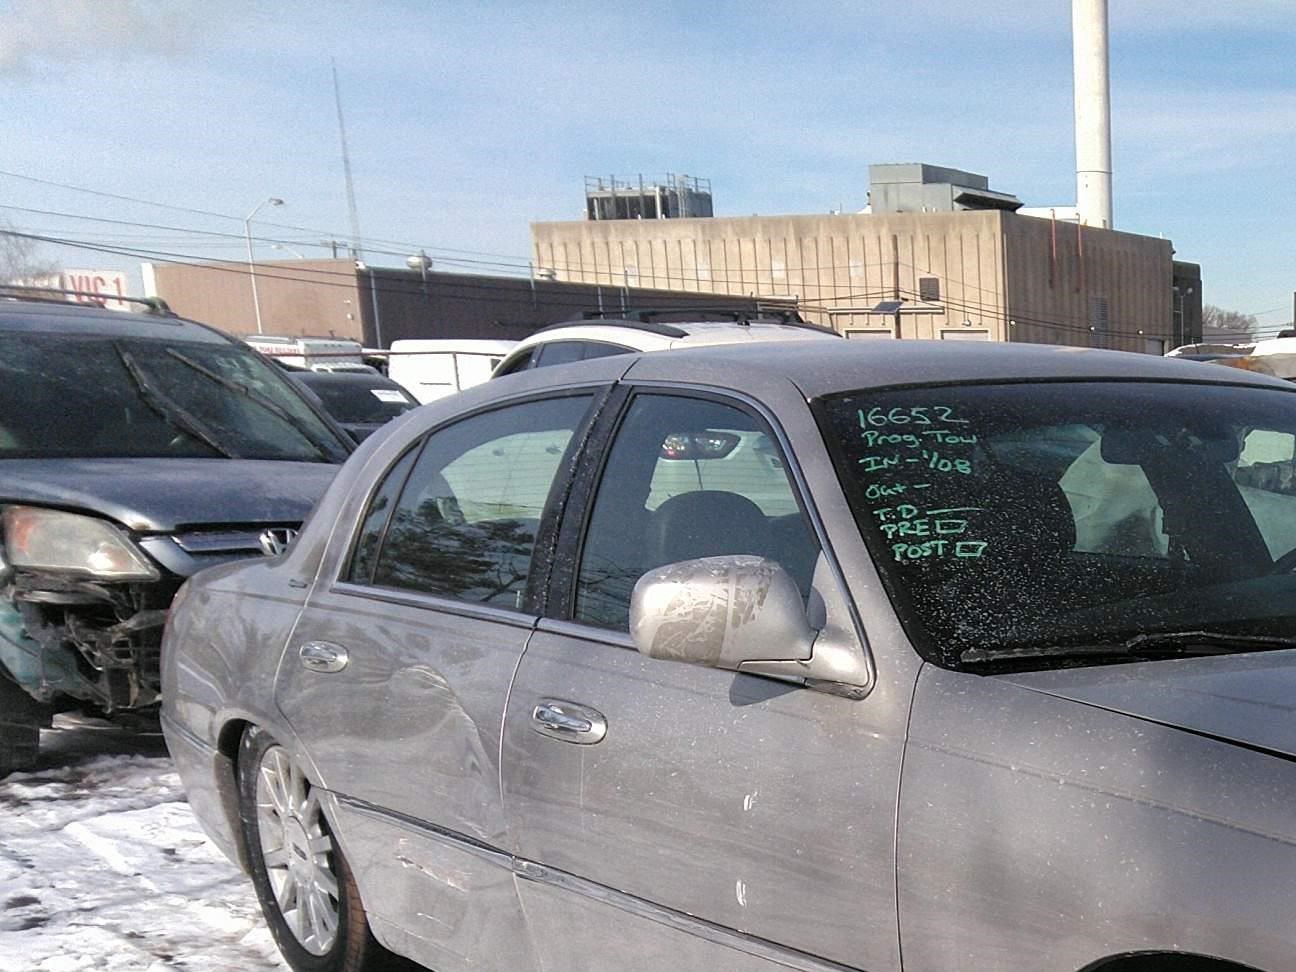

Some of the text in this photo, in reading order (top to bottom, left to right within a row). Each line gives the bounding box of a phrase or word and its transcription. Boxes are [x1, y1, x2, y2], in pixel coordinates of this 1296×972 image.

[858, 406, 970, 429] 16652
[922, 430, 977, 444] Tow
[880, 519, 930, 539] PRE
[892, 540, 949, 561] POST
